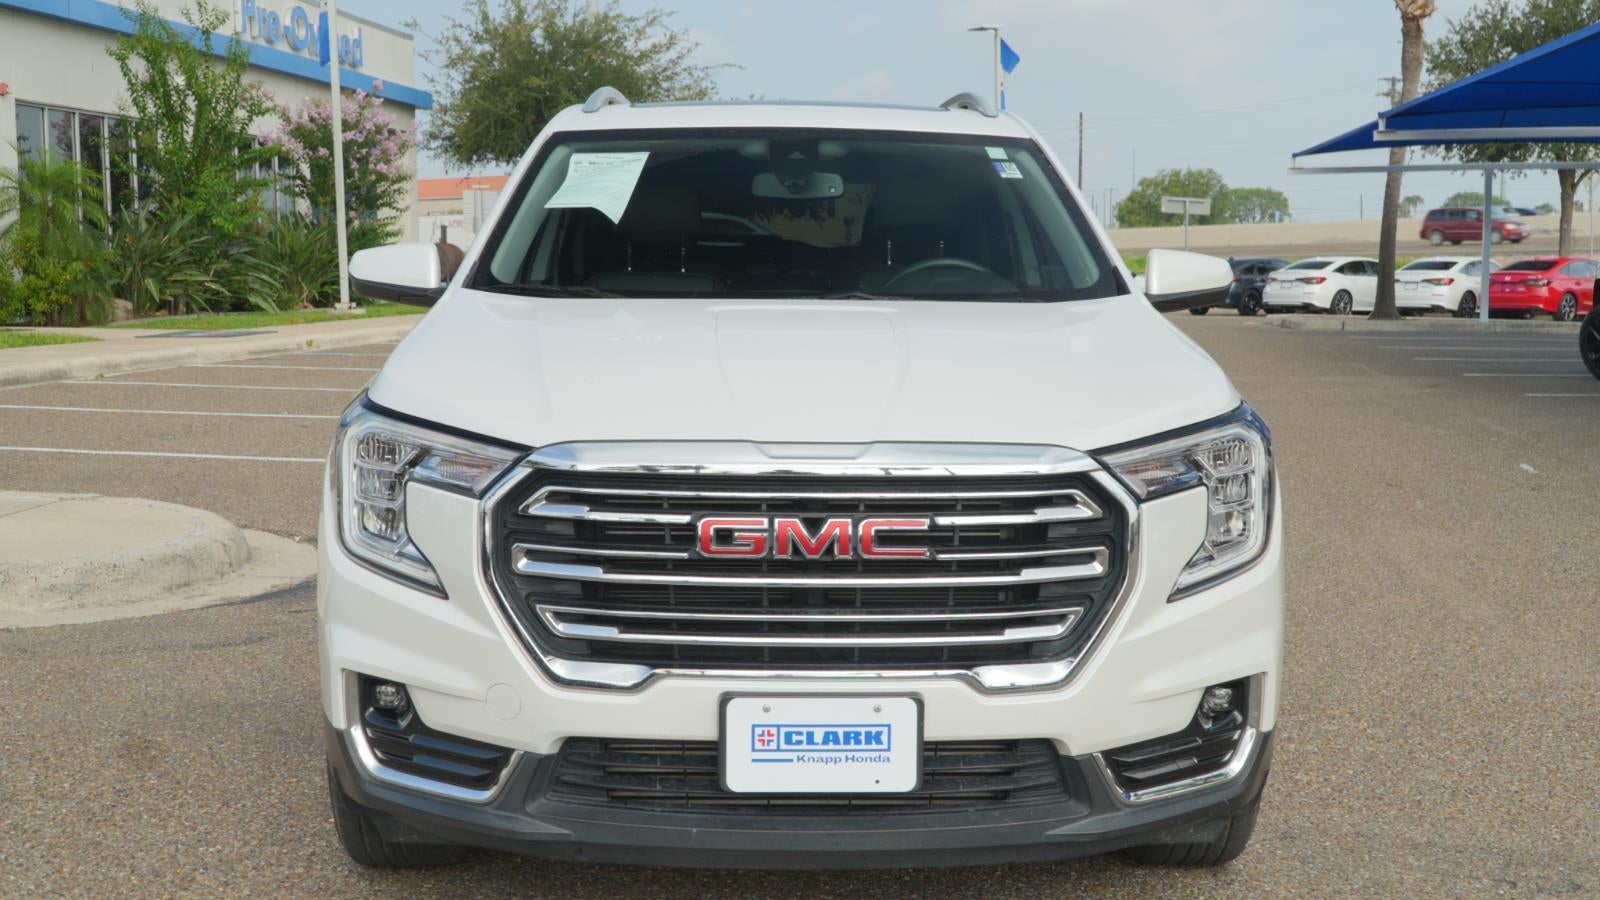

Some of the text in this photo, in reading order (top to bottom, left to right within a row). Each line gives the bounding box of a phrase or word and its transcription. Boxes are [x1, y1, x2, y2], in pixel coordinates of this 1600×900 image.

[241, 0, 363, 66] Pre-Oed
[697, 516, 931, 559] GMC
[784, 730, 884, 746] CLARK
[796, 754, 891, 765] Knapp Honda
